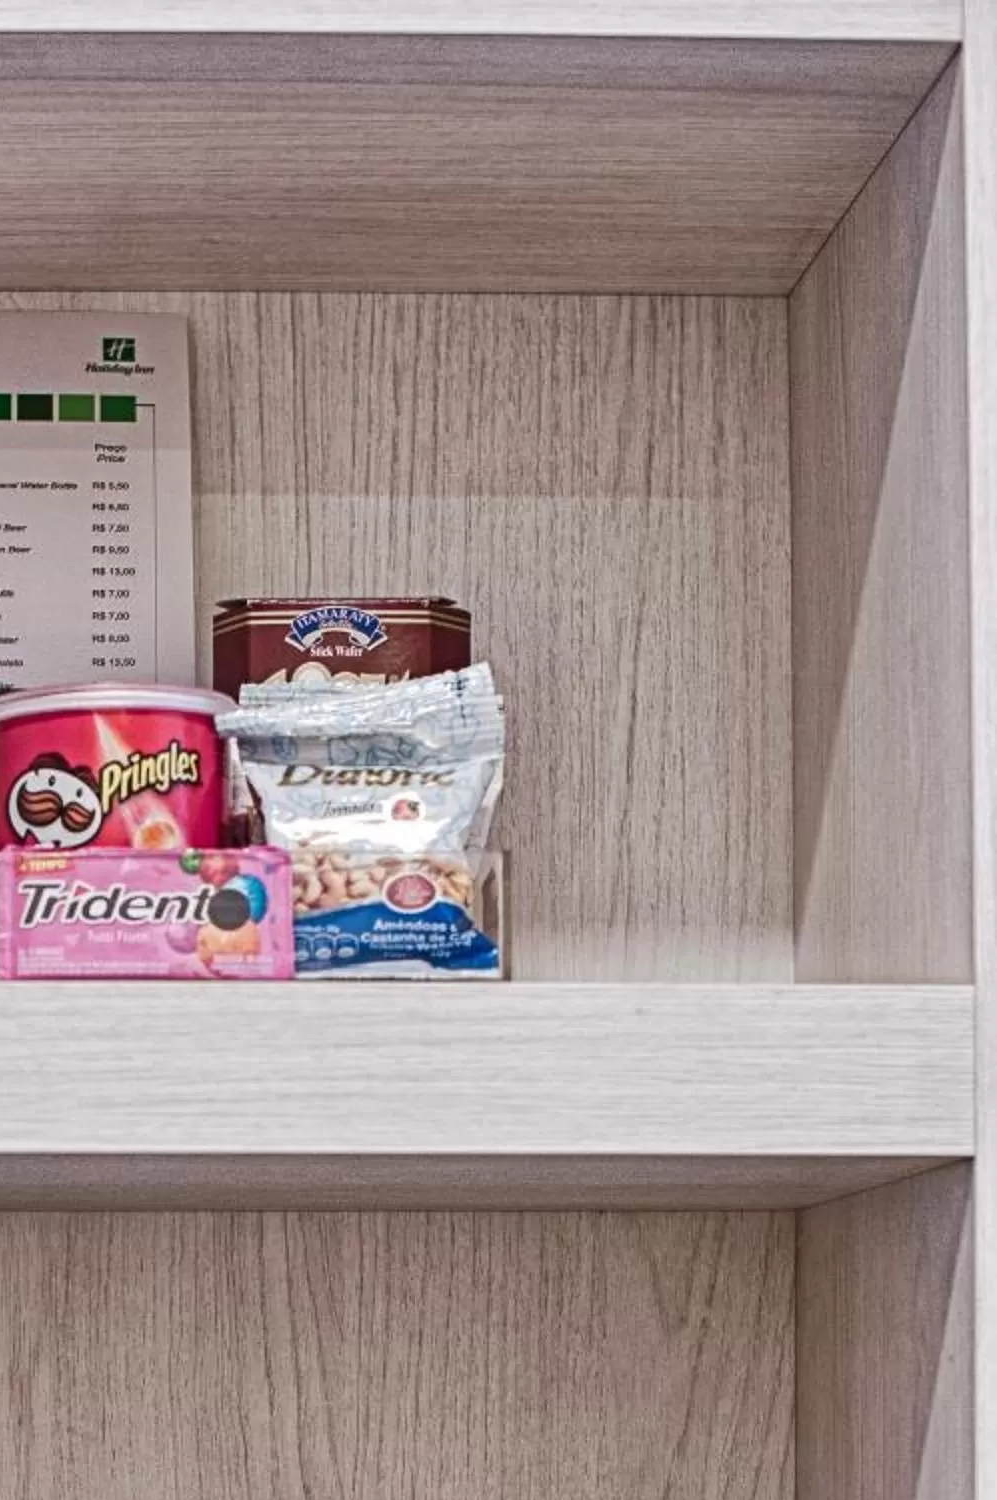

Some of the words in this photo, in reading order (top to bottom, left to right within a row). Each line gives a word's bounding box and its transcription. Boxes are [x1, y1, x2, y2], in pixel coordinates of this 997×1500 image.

[96, 454, 126, 463] Price
[92, 481, 105, 490] R$
[92, 503, 105, 511] R$
[92, 523, 105, 532] R$
[92, 546, 105, 554] R$
[92, 567, 105, 576] R$
[92, 590, 105, 598] R$
[92, 612, 105, 621] R$
[92, 634, 105, 643] R$
[310, 647, 333, 657] Stick
[335, 646, 364, 657] Wafer
[92, 657, 105, 666] R$
[101, 740, 200, 815] Pringles
[19, 880, 215, 927] Trident
[361, 931, 425, 944] Castanha
